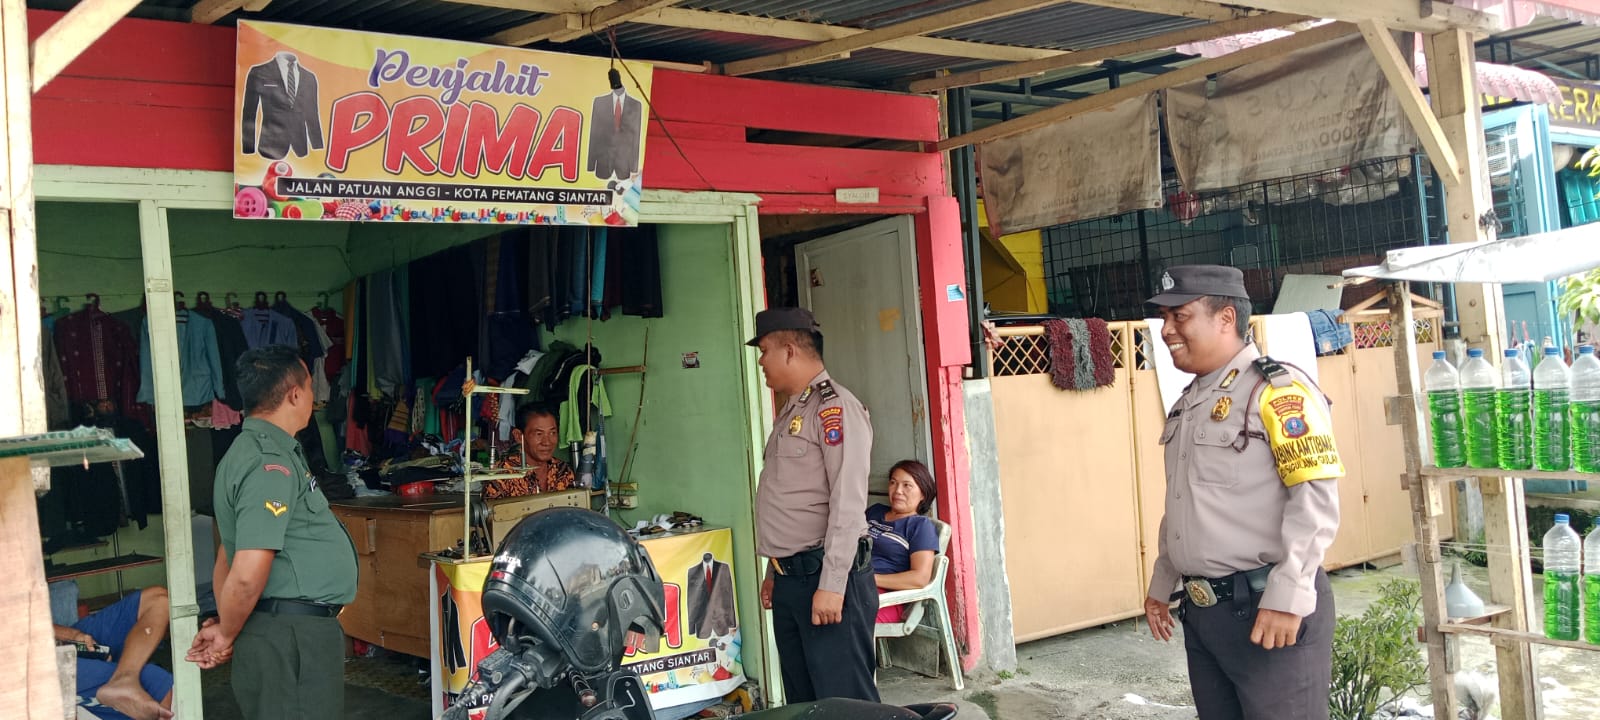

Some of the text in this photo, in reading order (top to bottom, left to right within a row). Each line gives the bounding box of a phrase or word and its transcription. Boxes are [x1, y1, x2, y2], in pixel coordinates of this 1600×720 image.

[368, 48, 549, 105] Penjahit
[325, 91, 583, 183] PRIMA
[286, 182, 332, 194] JALAN
[338, 183, 388, 196] PATUAN
[396, 185, 441, 198] ANGGI
[454, 187, 489, 200] KOTA
[492, 188, 555, 202] PEMATANG
[558, 190, 607, 203] SIANTAR
[667, 652, 710, 667] SIANTAR
